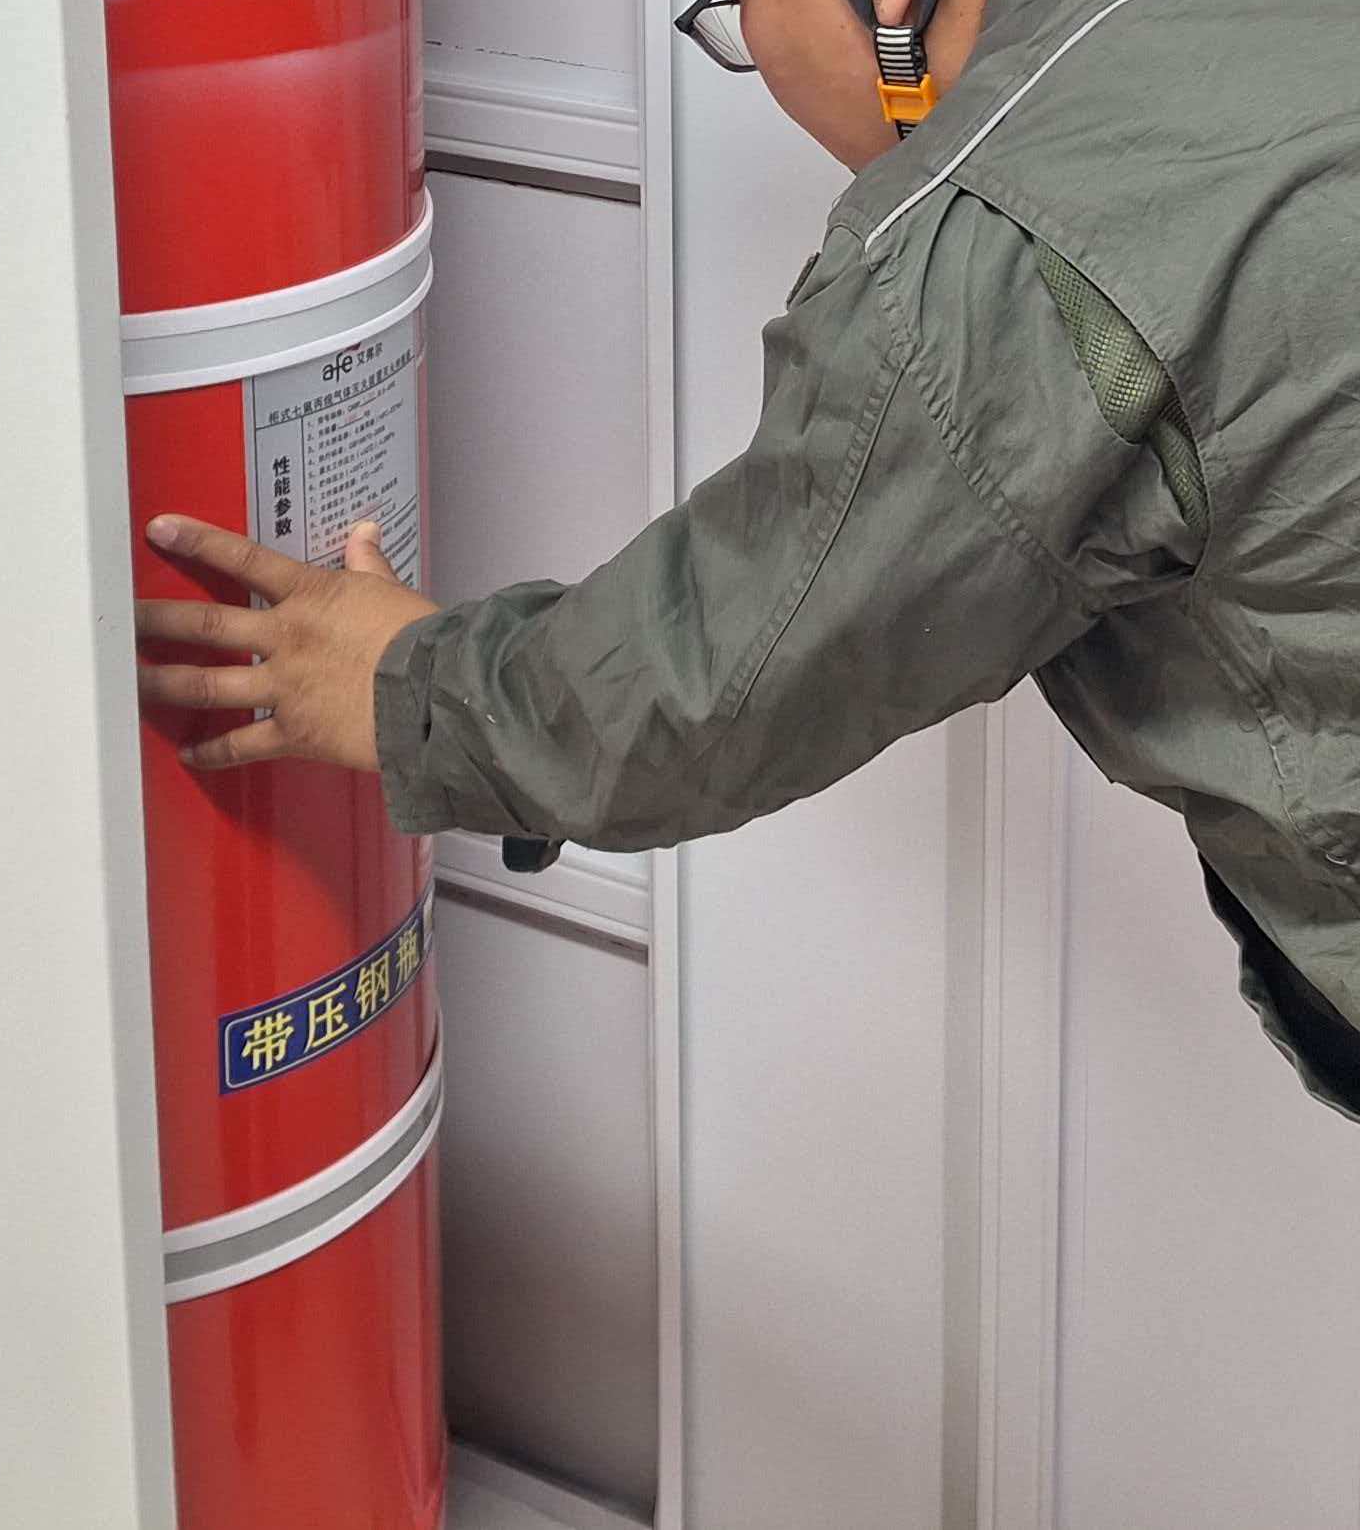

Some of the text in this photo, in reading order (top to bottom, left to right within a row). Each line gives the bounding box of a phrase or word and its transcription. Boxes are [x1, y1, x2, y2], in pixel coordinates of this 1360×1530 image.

[322, 350, 353, 382] afe
[272, 454, 293, 540] 性能参数
[241, 927, 419, 1072] 带压钢瓶
